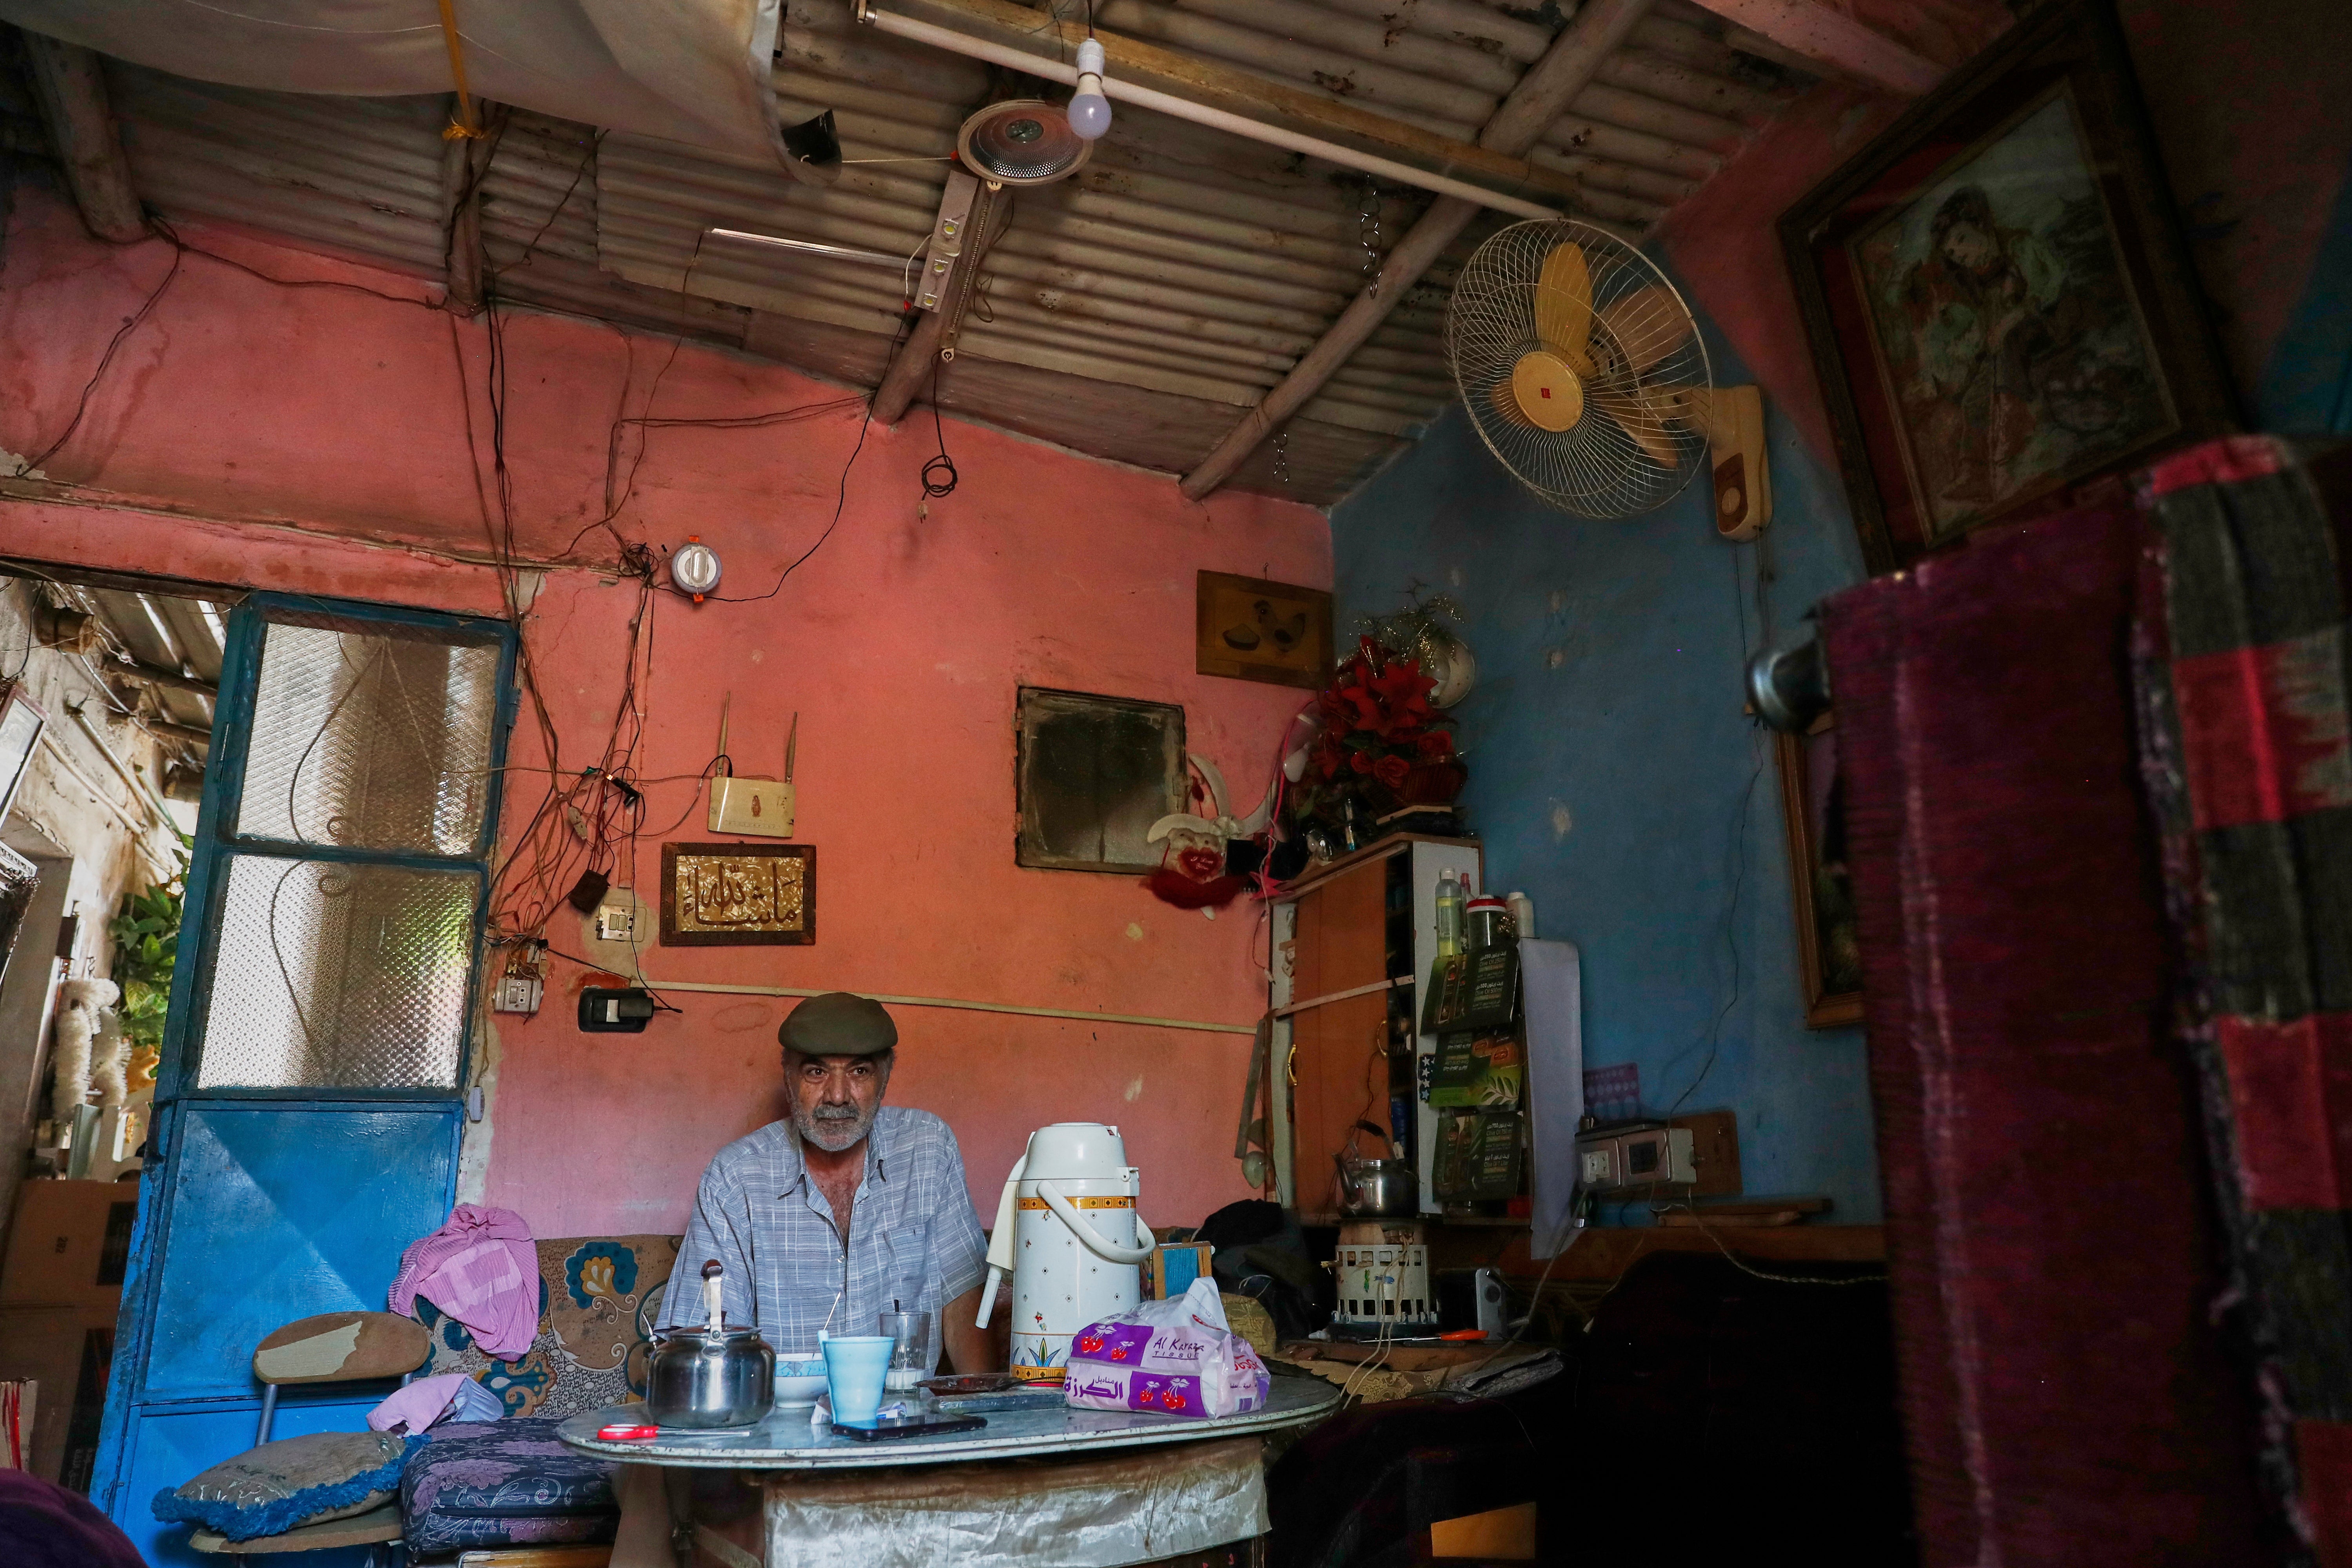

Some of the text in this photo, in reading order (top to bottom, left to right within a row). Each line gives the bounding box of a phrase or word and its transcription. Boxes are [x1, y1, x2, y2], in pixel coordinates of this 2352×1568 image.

[1153, 1337, 1205, 1352] Al Karaza
[1065, 1376, 1124, 1400] الكرزة
